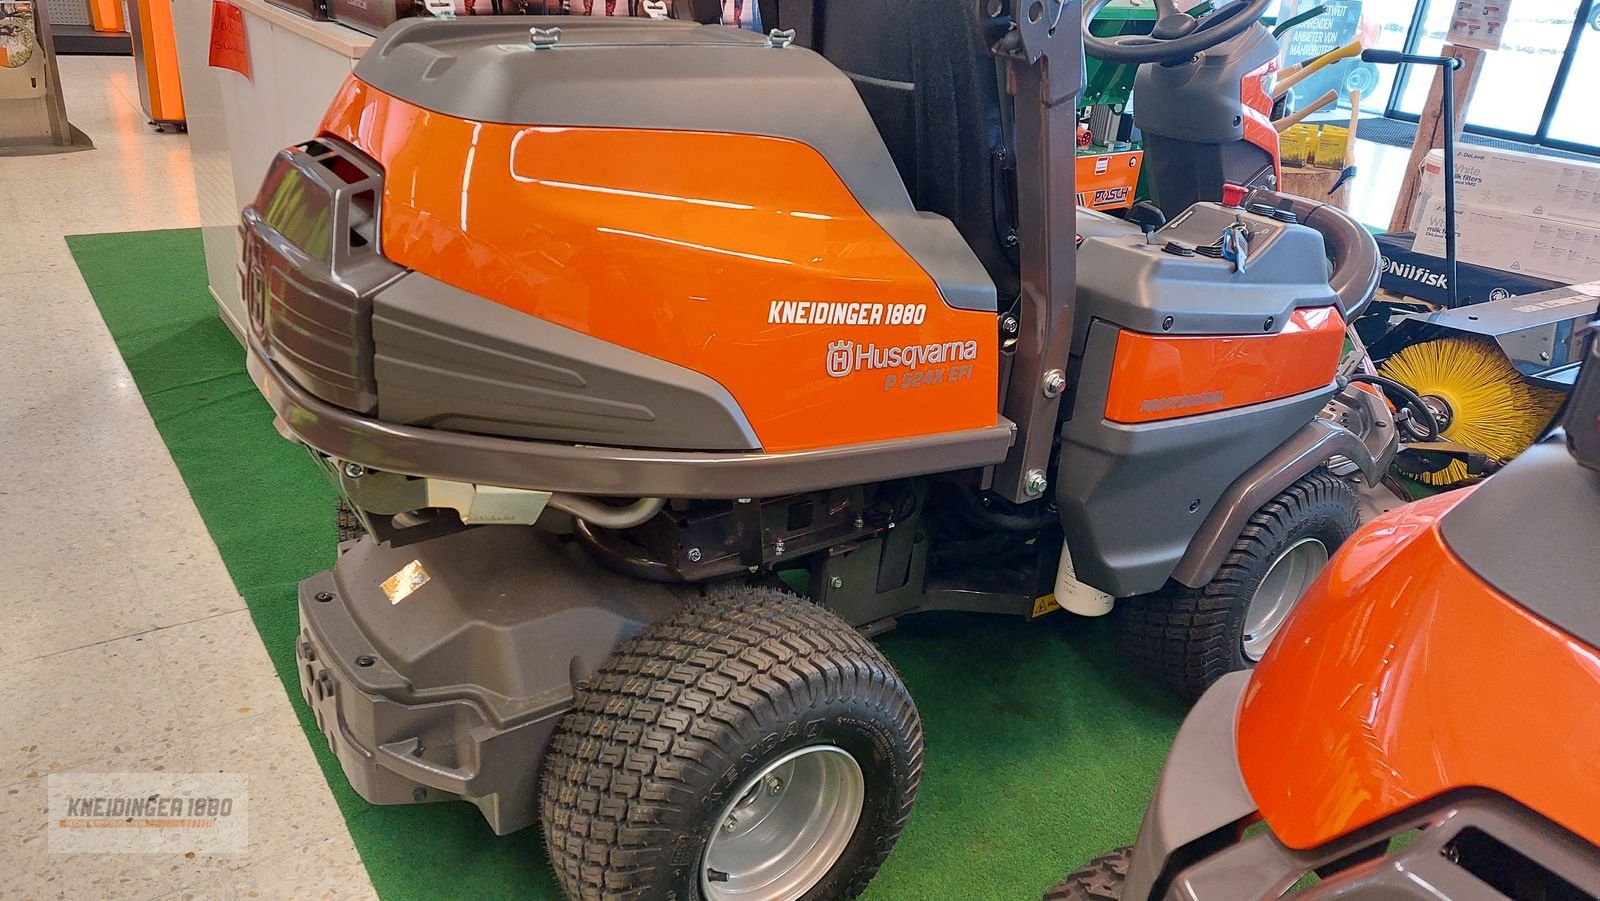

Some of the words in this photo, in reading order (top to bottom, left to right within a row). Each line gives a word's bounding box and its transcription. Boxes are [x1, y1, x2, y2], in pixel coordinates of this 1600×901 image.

[1094, 187, 1129, 202] POSCH
[1389, 261, 1448, 290] Nilfisk
[768, 300, 884, 325] KNEIDINGER
[884, 303, 927, 325] 1880
[855, 340, 977, 370] Husqvarna
[883, 374, 898, 391] P
[901, 367, 946, 389] 524X
[948, 364, 974, 382] EFI
